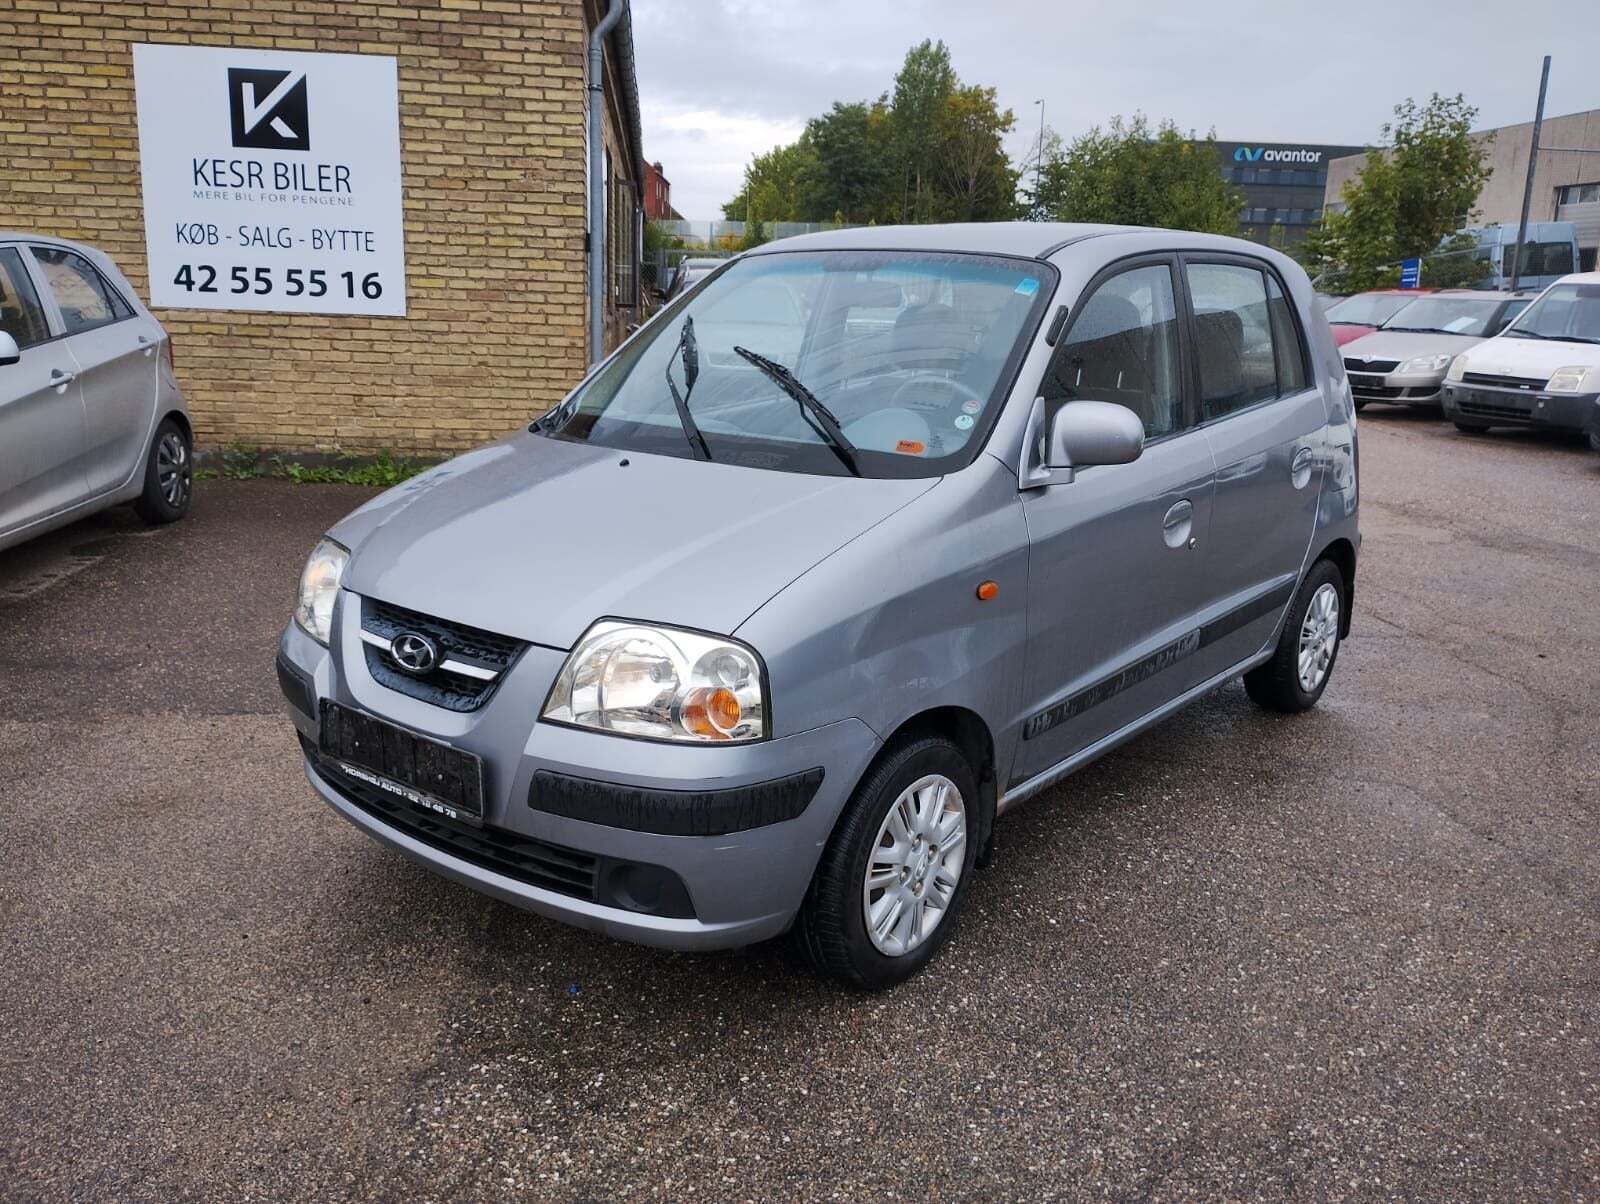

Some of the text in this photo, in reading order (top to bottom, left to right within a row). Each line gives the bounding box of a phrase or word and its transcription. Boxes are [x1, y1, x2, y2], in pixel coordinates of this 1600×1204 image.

[1264, 149, 1322, 163] avantor
[192, 157, 352, 194] KESR BILER
[193, 190, 354, 207] MERE BIL FOR PENGENE
[175, 222, 219, 246] KØB
[239, 225, 292, 249] SALG
[312, 228, 376, 253] BYTTE
[173, 264, 383, 300] 42 55 55 16
